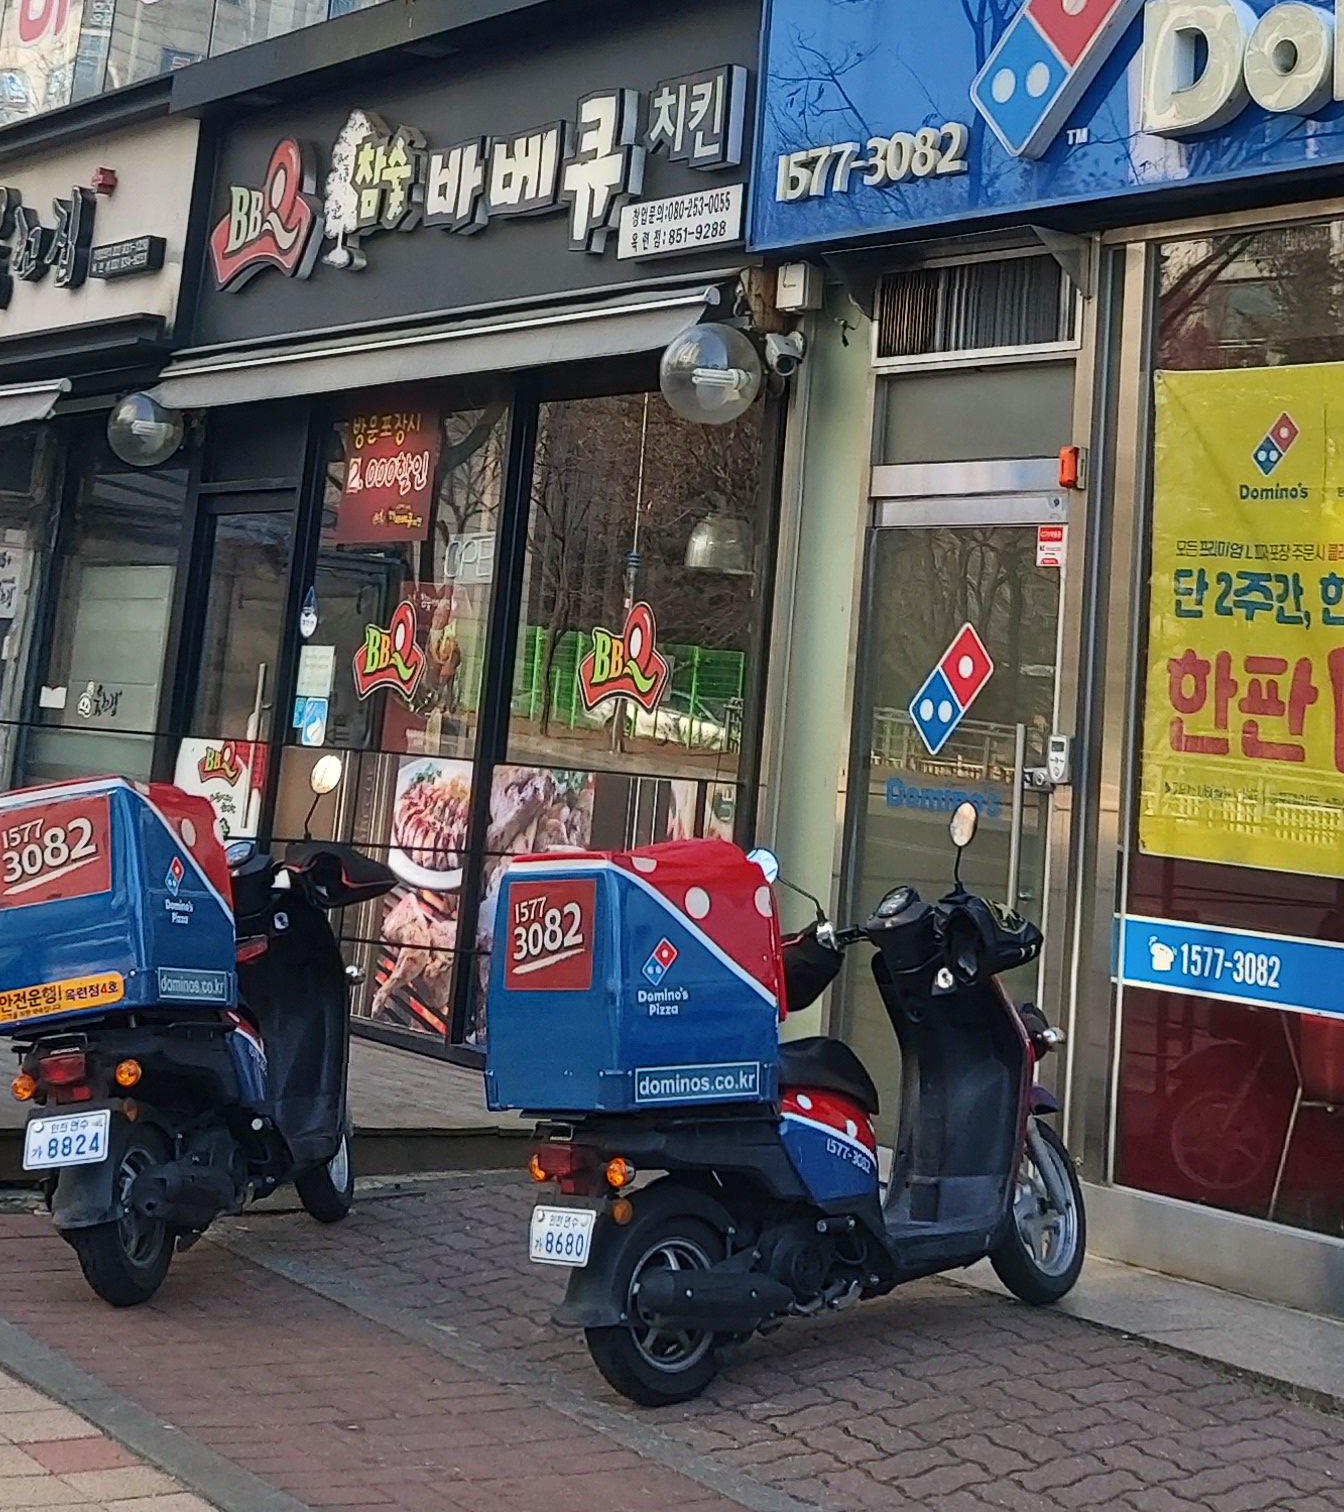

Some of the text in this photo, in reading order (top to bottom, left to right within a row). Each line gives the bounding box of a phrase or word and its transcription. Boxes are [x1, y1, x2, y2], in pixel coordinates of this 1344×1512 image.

[230, 137, 306, 254] BBQ
[426, 93, 624, 242] 바베큐
[647, 74, 725, 160] 치킨
[775, 122, 969, 203] 1577-3082
[1239, 482, 1309, 500] Domino's
[444, 539, 494, 578] OPE
[1175, 540, 1198, 557] 모든
[1199, 540, 1244, 559] 프리미엄
[1245, 544, 1252, 559] L
[1174, 568, 1209, 619] 단
[363, 602, 419, 681] BBQ
[591, 602, 655, 693] BBQ
[1167, 647, 1319, 763] 한판
[204, 741, 238, 779] BBQ
[1, 817, 98, 883] 3082
[2, 817, 44, 850] 1577
[164, 899, 195, 914] Domino's
[171, 912, 190, 924] Pizza
[514, 894, 547, 925] 1577
[512, 902, 584, 963] 3082
[1180, 942, 1282, 989] 1577-3082
[160, 975, 225, 995] dominos.co.kr
[637, 986, 690, 1005] Domino's
[648, 1001, 680, 1017] Pizza
[638, 1067, 756, 1098] dominos.co.kr
[51, 1119, 88, 1134] 인천 연수
[31, 1132, 99, 1159] 가 8824
[826, 1138, 871, 1174] 1577-3082
[534, 1231, 584, 1257] 가 8680
